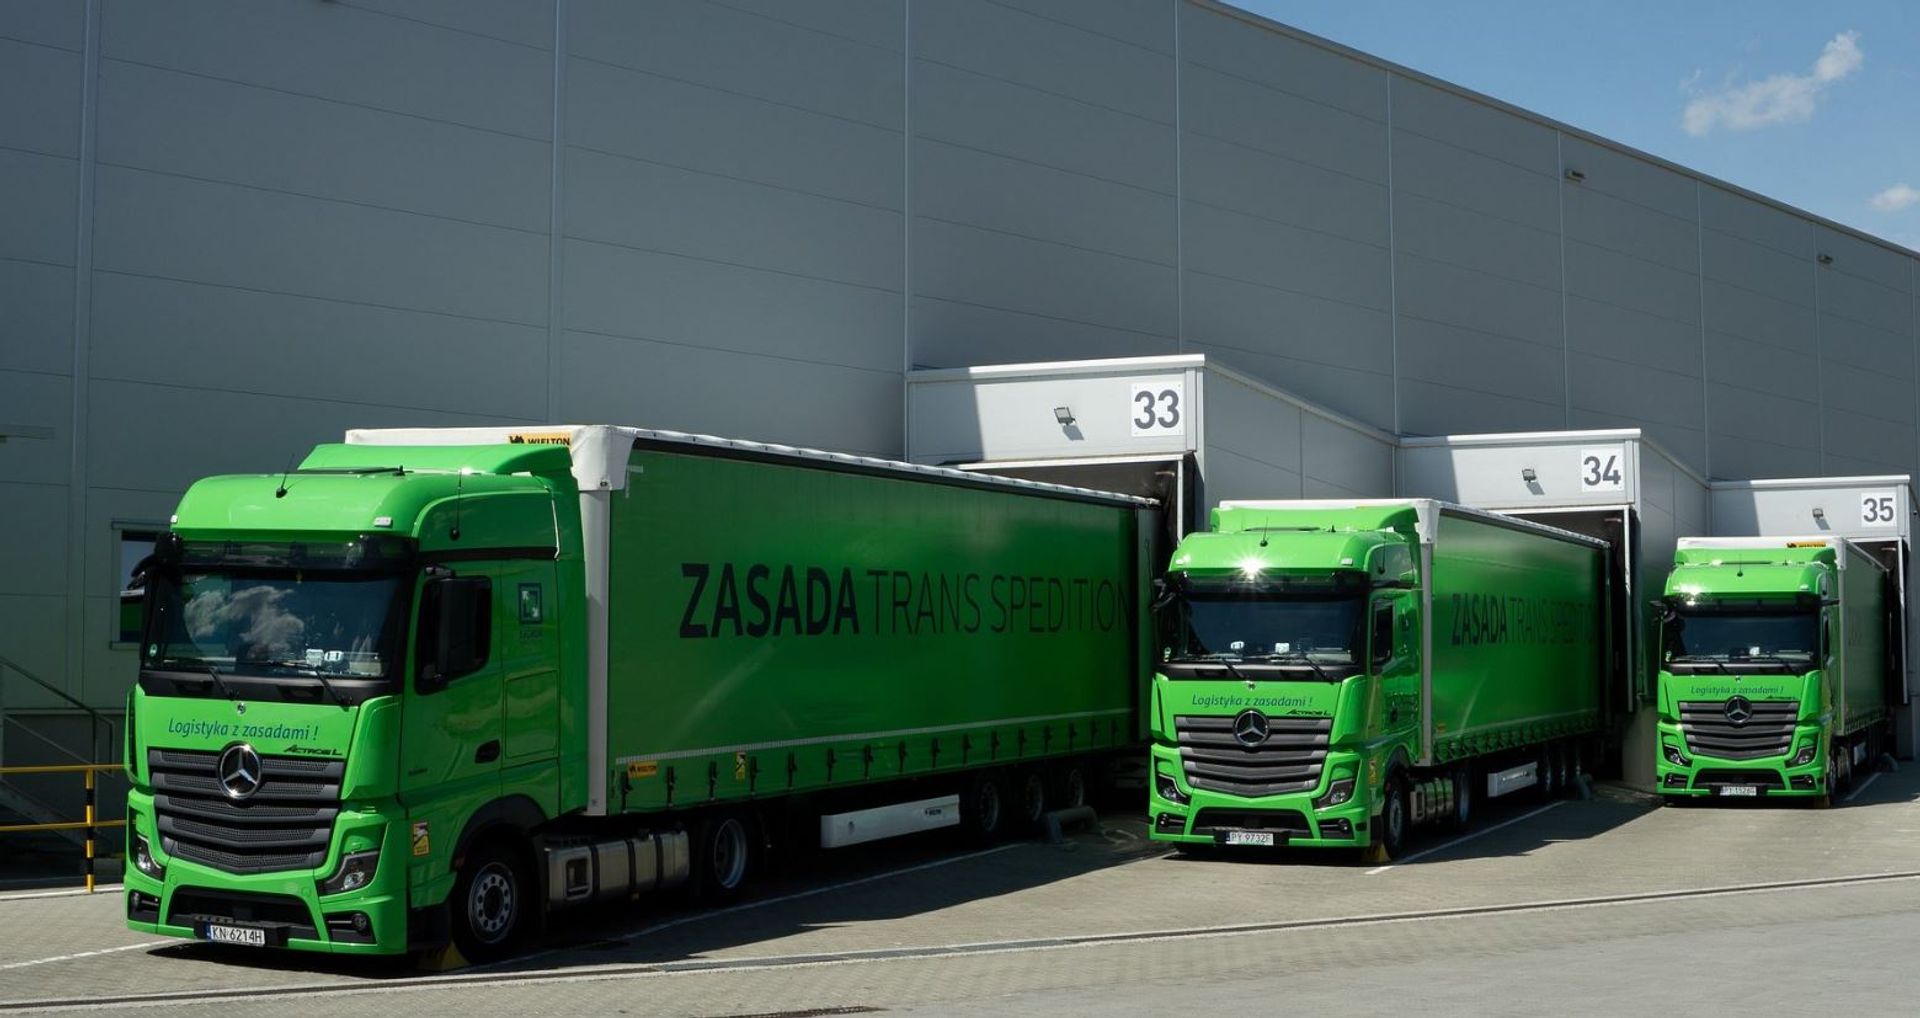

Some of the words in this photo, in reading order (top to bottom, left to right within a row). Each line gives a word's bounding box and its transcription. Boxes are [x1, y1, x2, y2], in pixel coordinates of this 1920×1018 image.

[1134, 390, 1180, 430] 33
[1583, 455, 1622, 486] 34
[1863, 497, 1894, 522] 35
[679, 562, 860, 639] ZASADA
[866, 569, 982, 636] TRANS
[1451, 592, 1508, 646] ZASADA
[1192, 693, 1243, 708] Logistyka
[1253, 695, 1307, 707] zasadami
[168, 718, 229, 740] Logistyka
[232, 724, 239, 737] z
[242, 722, 311, 741] zasadami
[313, 726, 318, 741] !
[212, 925, 227, 940] KN
[230, 928, 262, 943] 6214H
